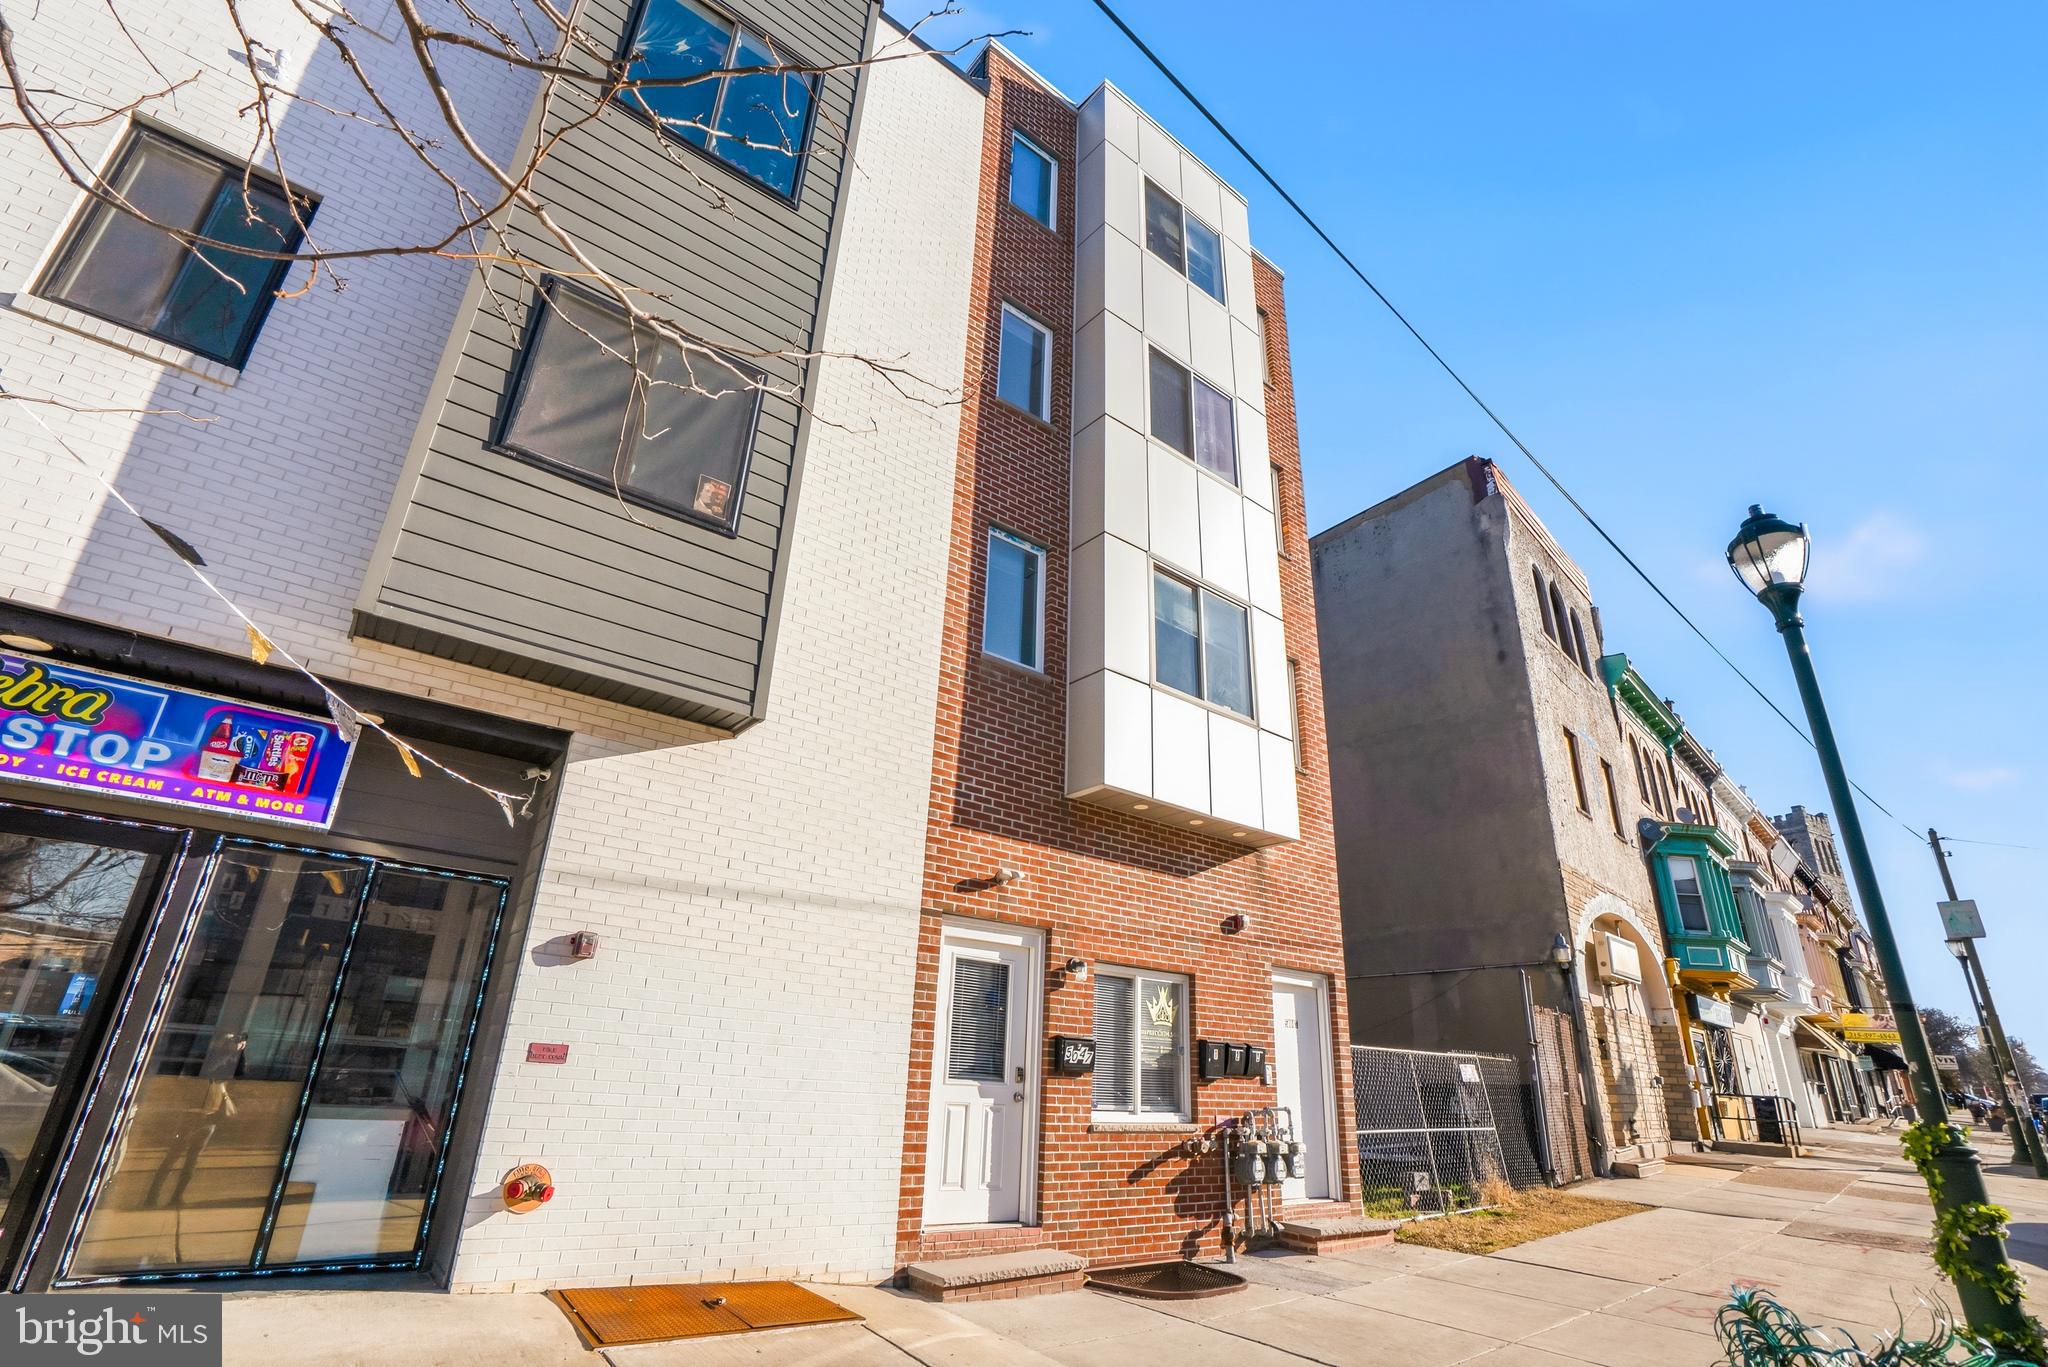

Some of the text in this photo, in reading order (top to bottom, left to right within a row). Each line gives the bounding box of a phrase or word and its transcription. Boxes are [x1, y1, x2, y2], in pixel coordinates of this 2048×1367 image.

[2, 717, 171, 769] STOP
[56, 764, 91, 779] ICE
[96, 770, 165, 791] CREAM
[191, 787, 232, 802] ATM
[236, 794, 249, 805] &
[255, 797, 305, 814] MORE
[1065, 1045, 1093, 1064] 5047
